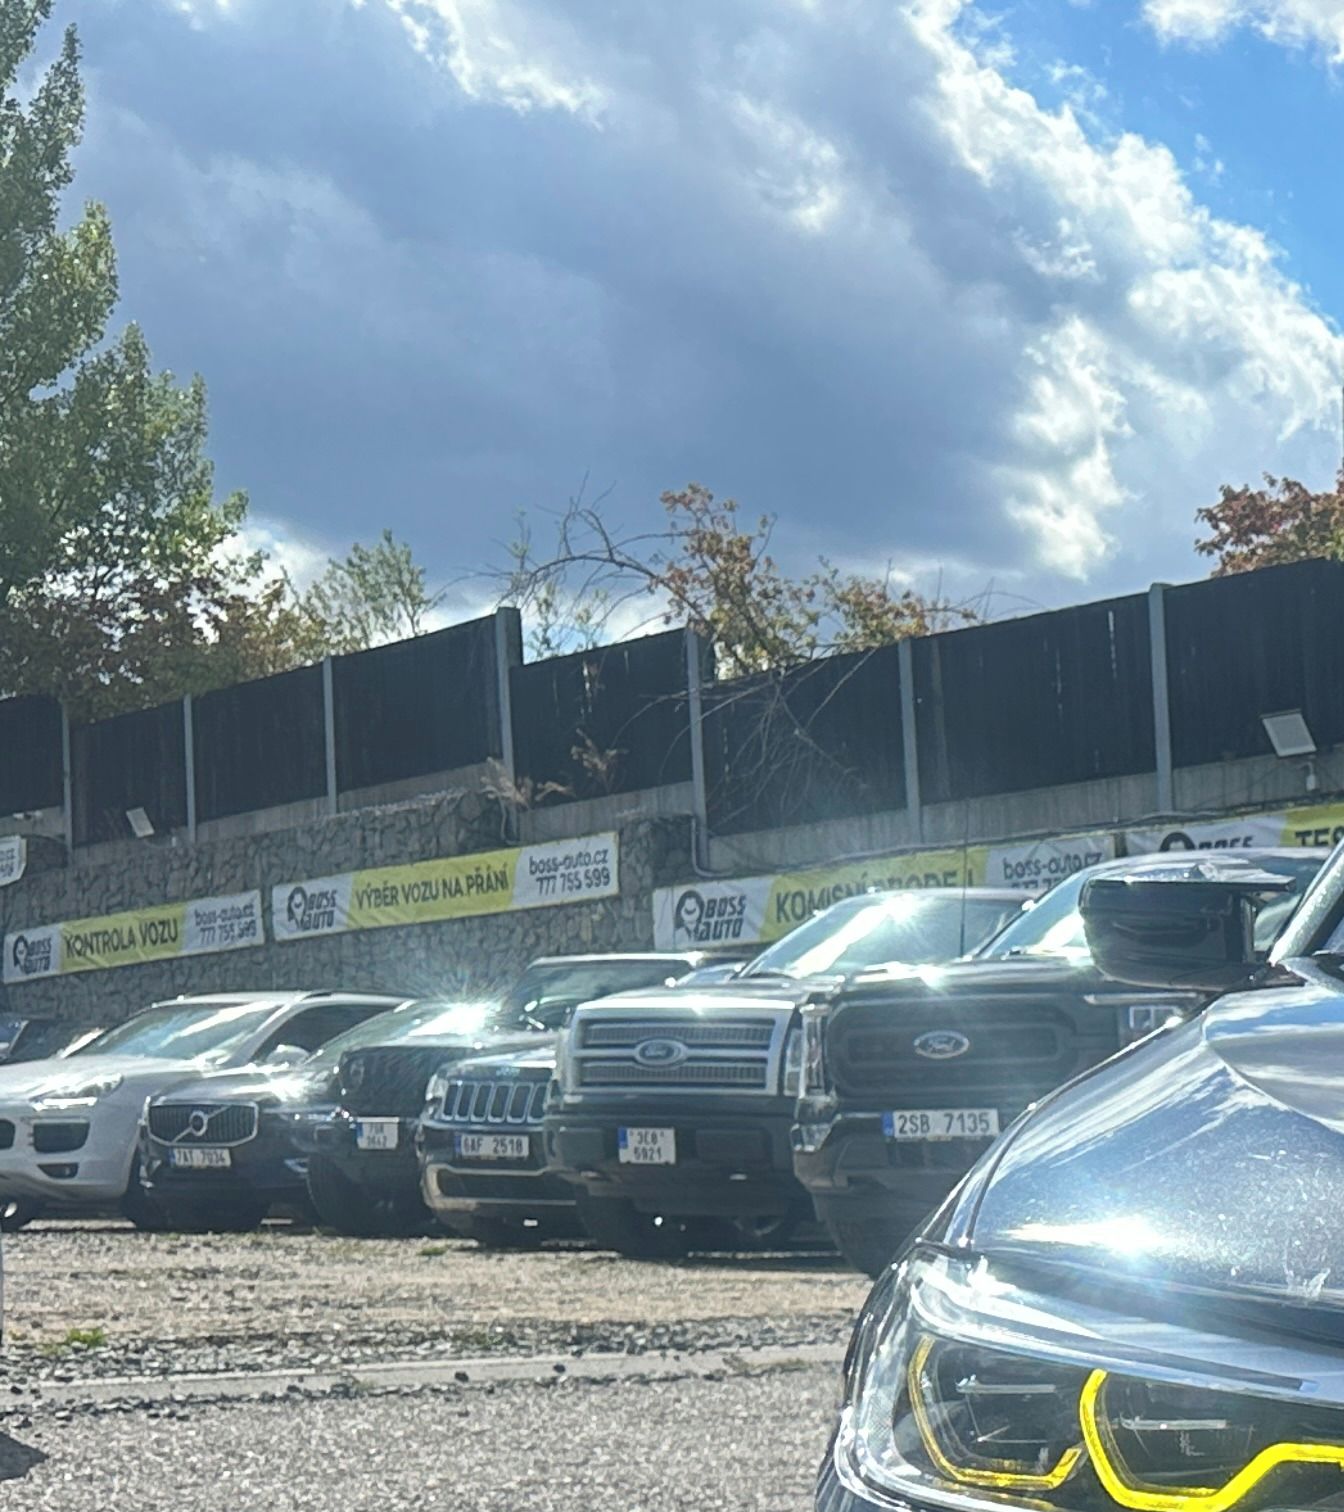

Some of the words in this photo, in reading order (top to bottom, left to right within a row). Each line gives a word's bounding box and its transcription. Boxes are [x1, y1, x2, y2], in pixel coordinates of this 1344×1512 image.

[528, 847, 608, 877] boss-auto.cz
[401, 879, 441, 904] VOZU
[442, 875, 464, 898] NA
[465, 862, 509, 895] PŘÁNÍ
[536, 875, 558, 896] 777
[560, 871, 583, 894] 755
[584, 867, 611, 889] 599
[705, 895, 746, 917] BOSS
[64, 925, 136, 958] KONTROLA
[139, 918, 178, 945] VOZU
[698, 917, 743, 941] AUTO
[898, 1114, 930, 1134] 2SB
[944, 1112, 990, 1133] 7135
